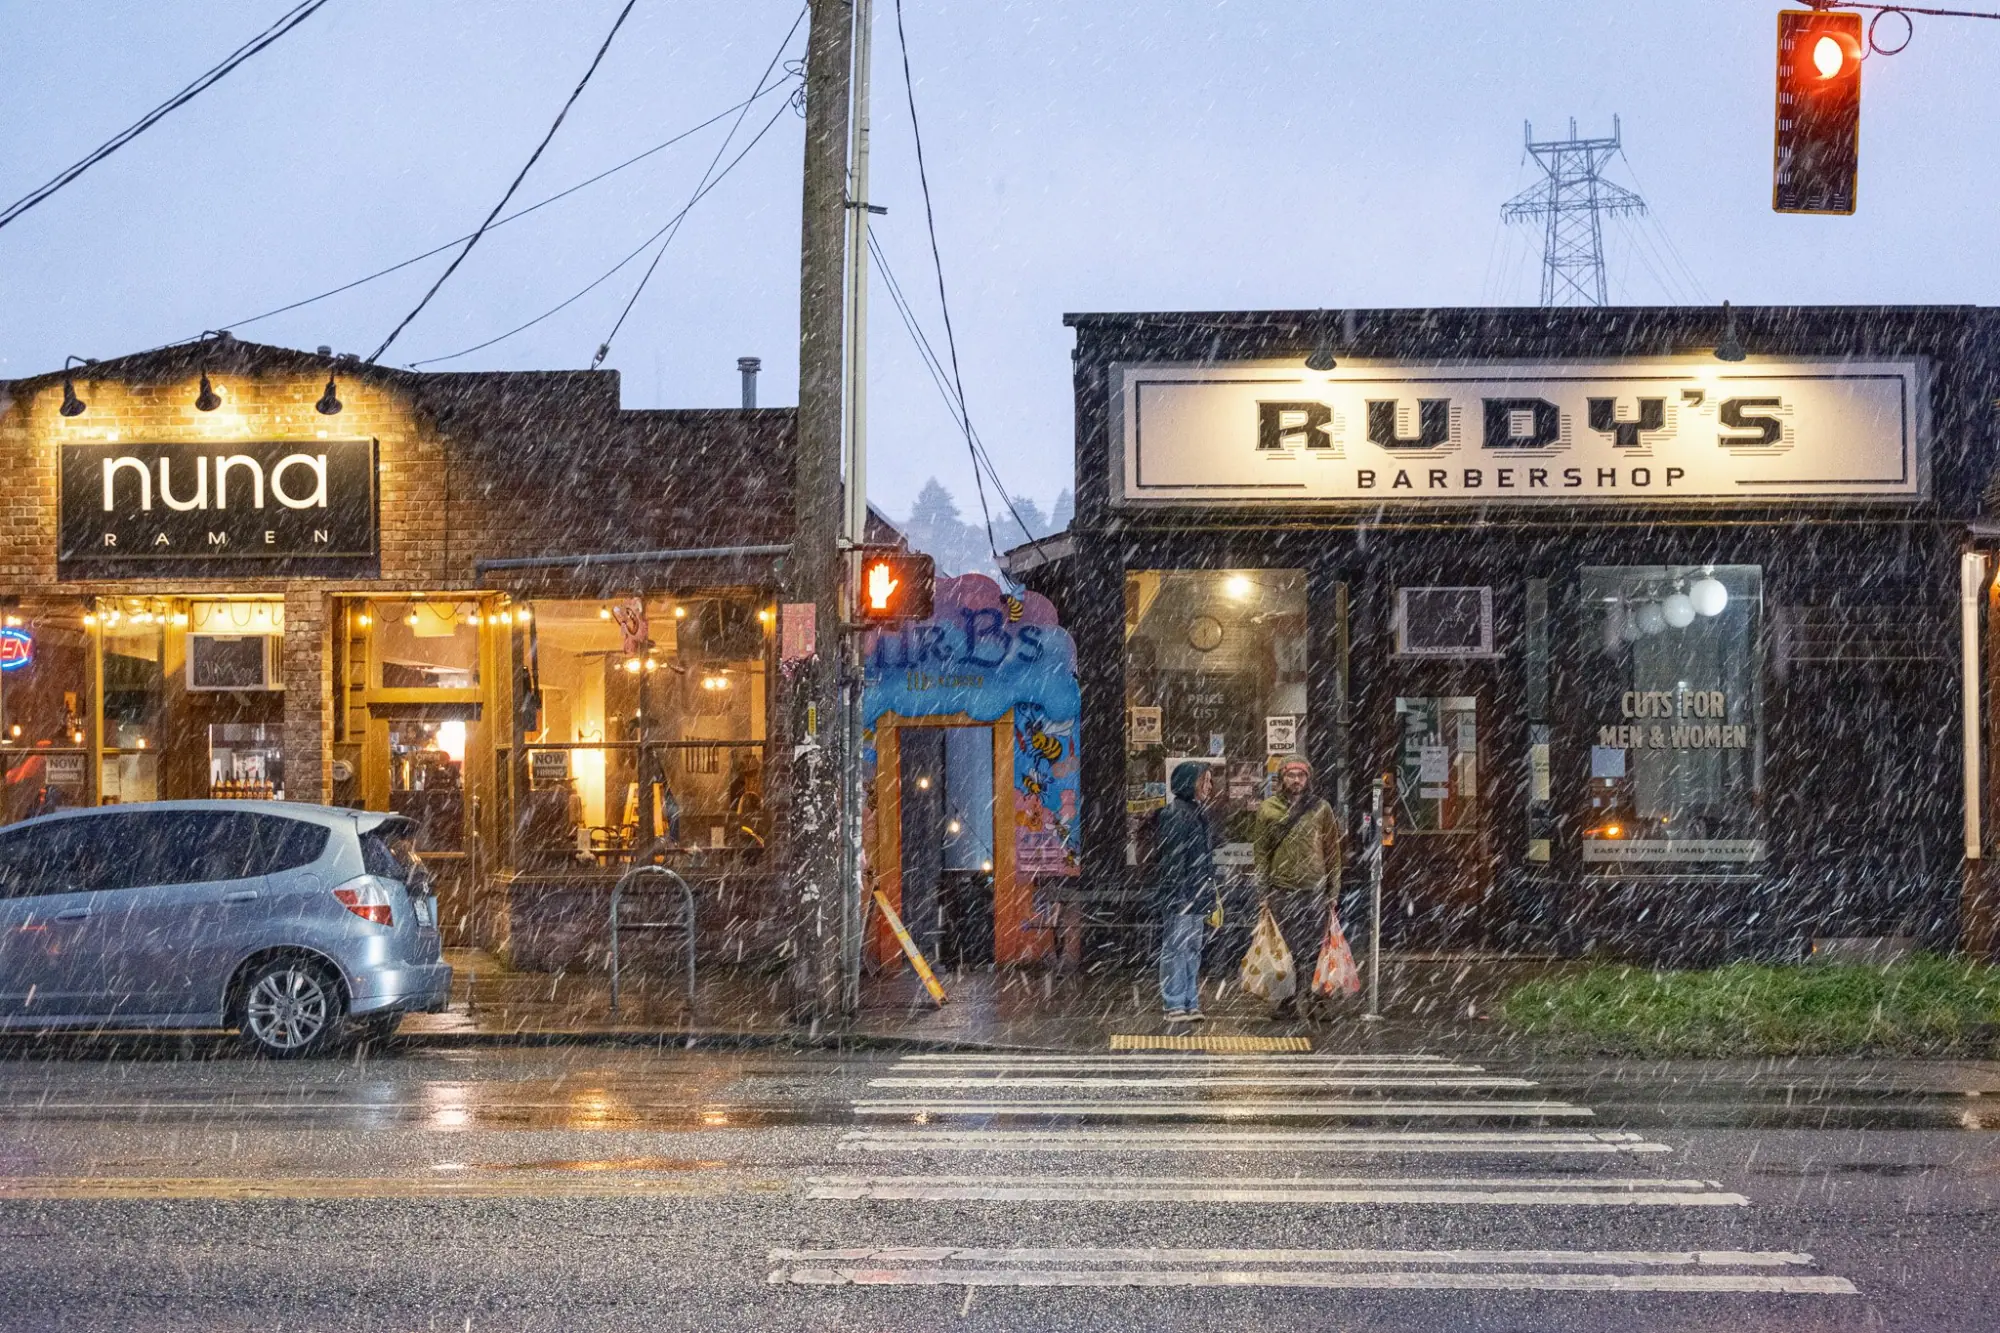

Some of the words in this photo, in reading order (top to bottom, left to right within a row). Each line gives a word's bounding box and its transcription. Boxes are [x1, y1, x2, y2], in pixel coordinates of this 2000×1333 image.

[1256, 387, 1795, 459] RUDY'S
[103, 453, 327, 511] nuna
[1356, 467, 1687, 490] BARBERSHOP
[104, 528, 329, 548] RAMEN
[1, 637, 32, 659] EN
[1188, 693, 1225, 704] PRICE
[1621, 691, 1673, 719] CUTS
[1682, 691, 1725, 719] FOR
[1193, 708, 1219, 719] LIST
[1599, 725, 1643, 749] MEN
[1649, 725, 1665, 749] &
[1670, 725, 1747, 749] WOMEN
[50, 758, 79, 768] NOW
[535, 754, 564, 765] NOW
[536, 768, 565, 777] HIRING
